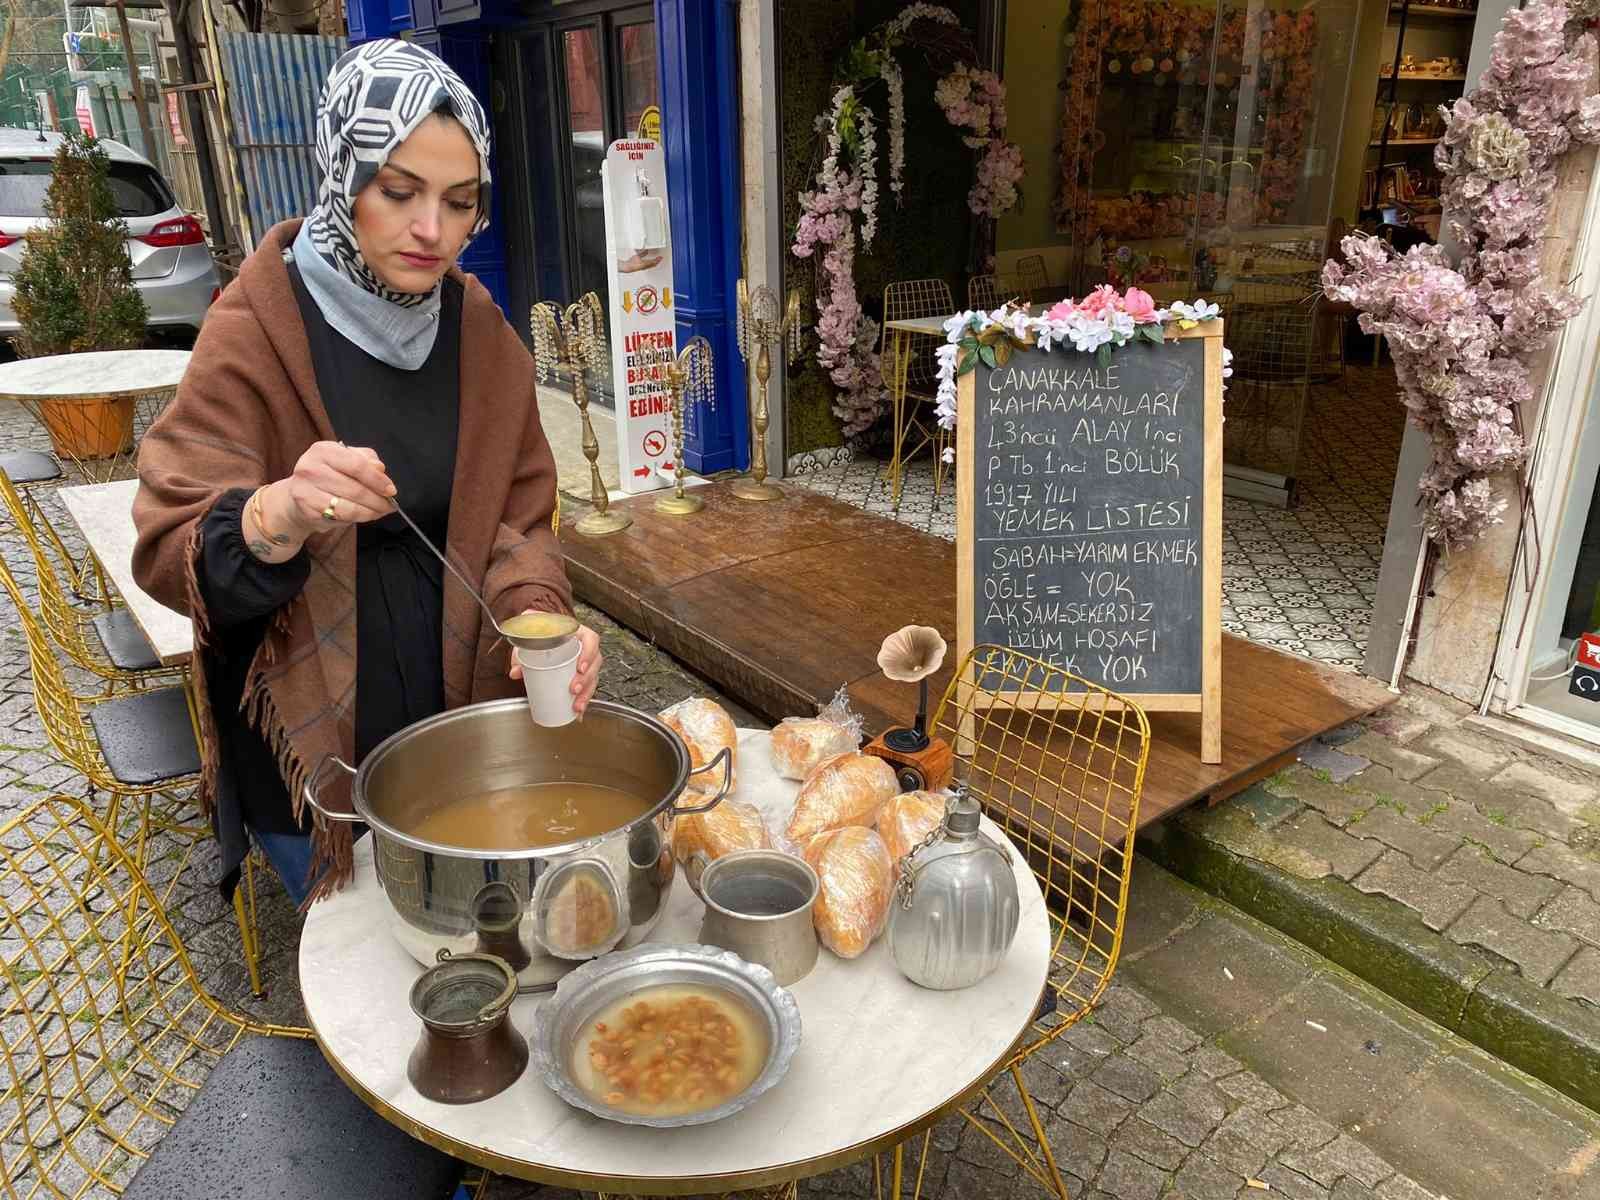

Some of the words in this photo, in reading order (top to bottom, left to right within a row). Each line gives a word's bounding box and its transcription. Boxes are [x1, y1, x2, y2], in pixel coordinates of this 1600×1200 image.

[989, 365, 1121, 392] ÇANAKKALE
[989, 392, 1180, 416] KAHRAMANLARI
[1071, 418, 1131, 445] ALAY
[988, 455, 1000, 480] P
[1105, 446, 1180, 479] BÖLÜK
[984, 480, 1033, 507] 1917
[1044, 482, 1077, 504] YILI
[992, 508, 1074, 534] YEMEK
[1087, 496, 1191, 531] LİSTESİ
[1133, 539, 1198, 566] EKMEK
[984, 572, 1038, 600] ÖĞLE
[1080, 570, 1135, 601] YOK
[1008, 627, 1063, 650] ÜZÜM
[1075, 628, 1156, 653] HOŞAFI
[1098, 654, 1148, 682] YOK
